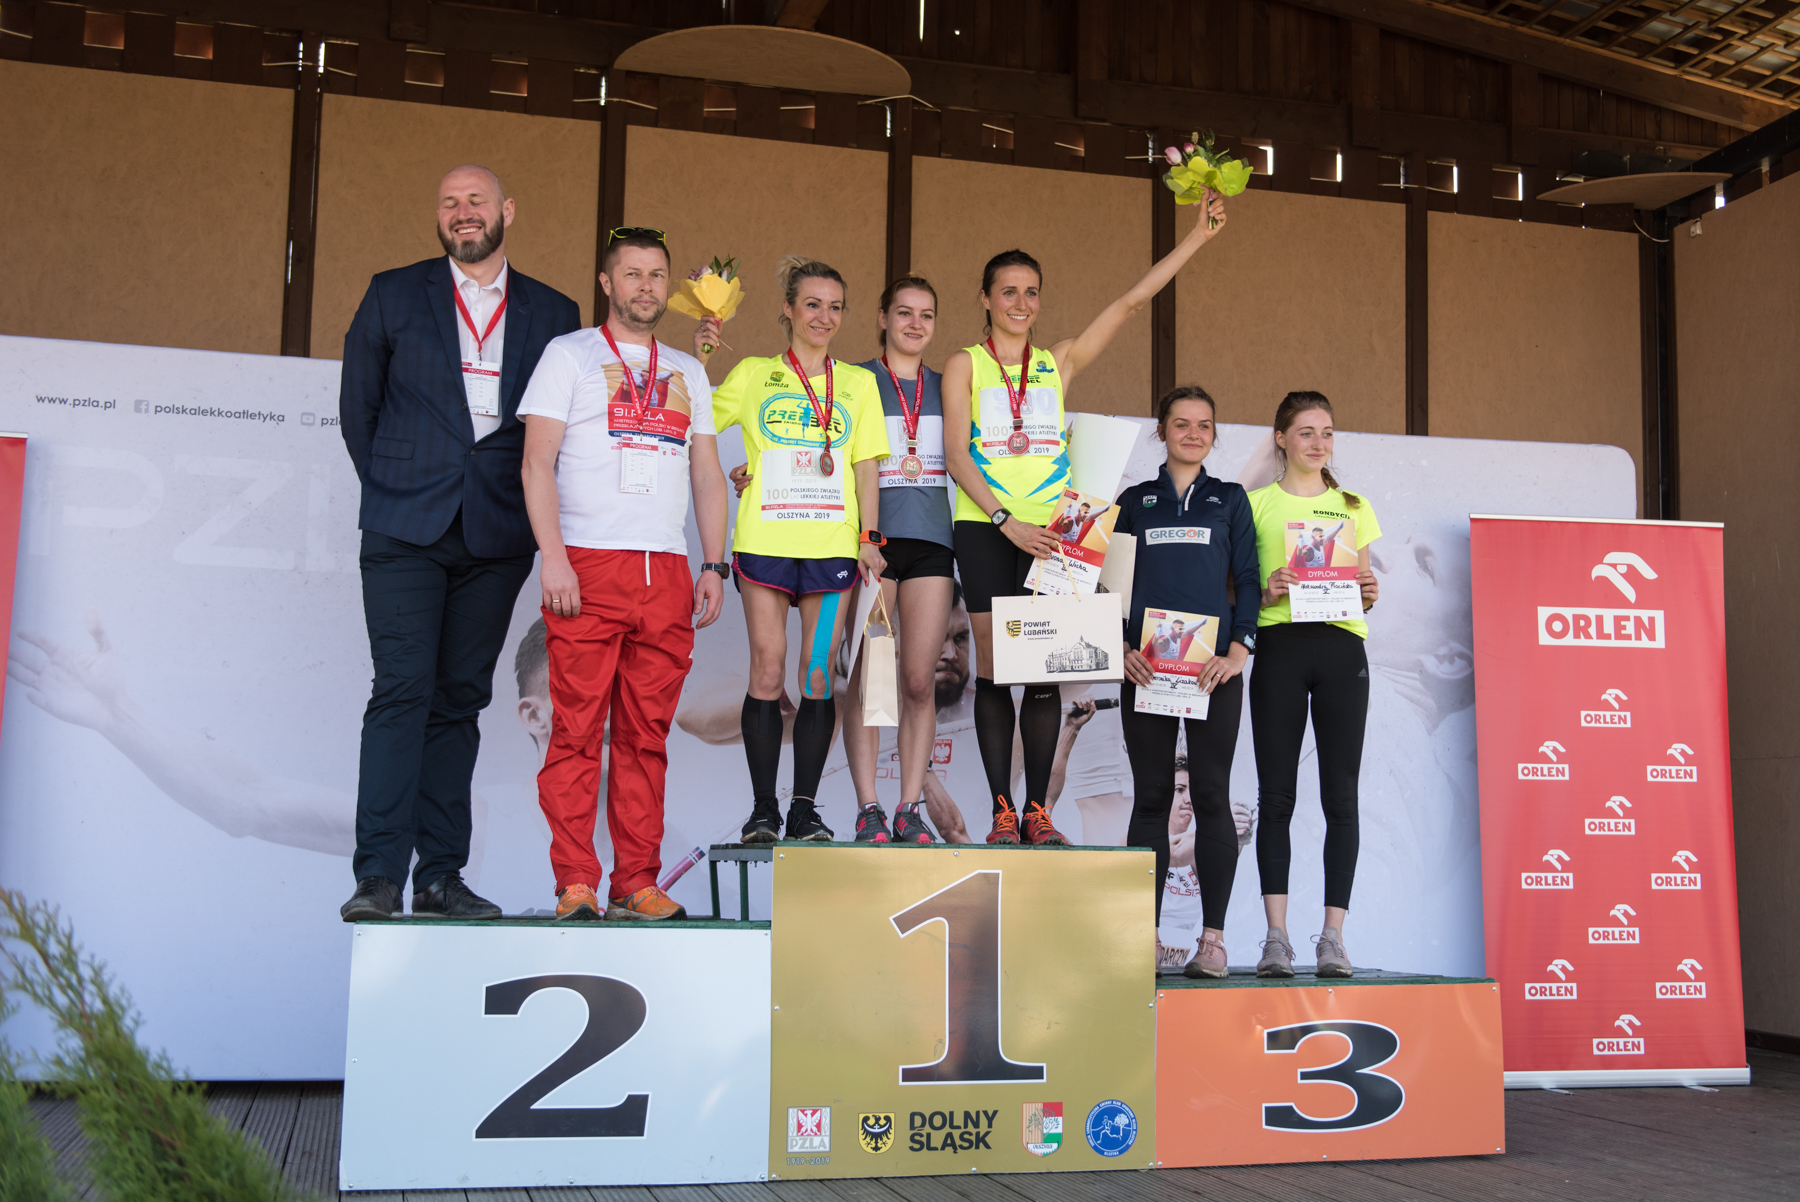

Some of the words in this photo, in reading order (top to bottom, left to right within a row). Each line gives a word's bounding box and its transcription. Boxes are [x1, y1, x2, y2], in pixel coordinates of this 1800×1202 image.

[36, 394, 116, 410] www.pzla.pl
[154, 402, 285, 422] polskalekkoatletyka
[767, 488, 789, 500] 100
[1150, 529, 1205, 539] GREGOR
[1545, 612, 1657, 642] ORLEN
[1159, 662, 1190, 672] DYPLOM
[1583, 713, 1627, 725] ORLEN
[1521, 766, 1566, 777] ORLEN
[1650, 768, 1694, 779] ORLEN
[1588, 821, 1632, 832] ORLEN
[1524, 875, 1570, 886] ORLEN
[1654, 876, 1698, 887] ORLEN
[1591, 930, 1636, 941] ORLEN
[890, 869, 1047, 1086] 1
[1528, 986, 1574, 997] ORLEN
[1658, 985, 1702, 996] ORLEN
[1596, 1040, 1641, 1052] ORLEN
[475, 973, 650, 1141] 2
[1262, 1020, 1405, 1134] 3
[909, 1109, 999, 1130] DOLNY
[790, 1138, 827, 1150] PZLA
[908, 1128, 992, 1154] ŚLĄSK
